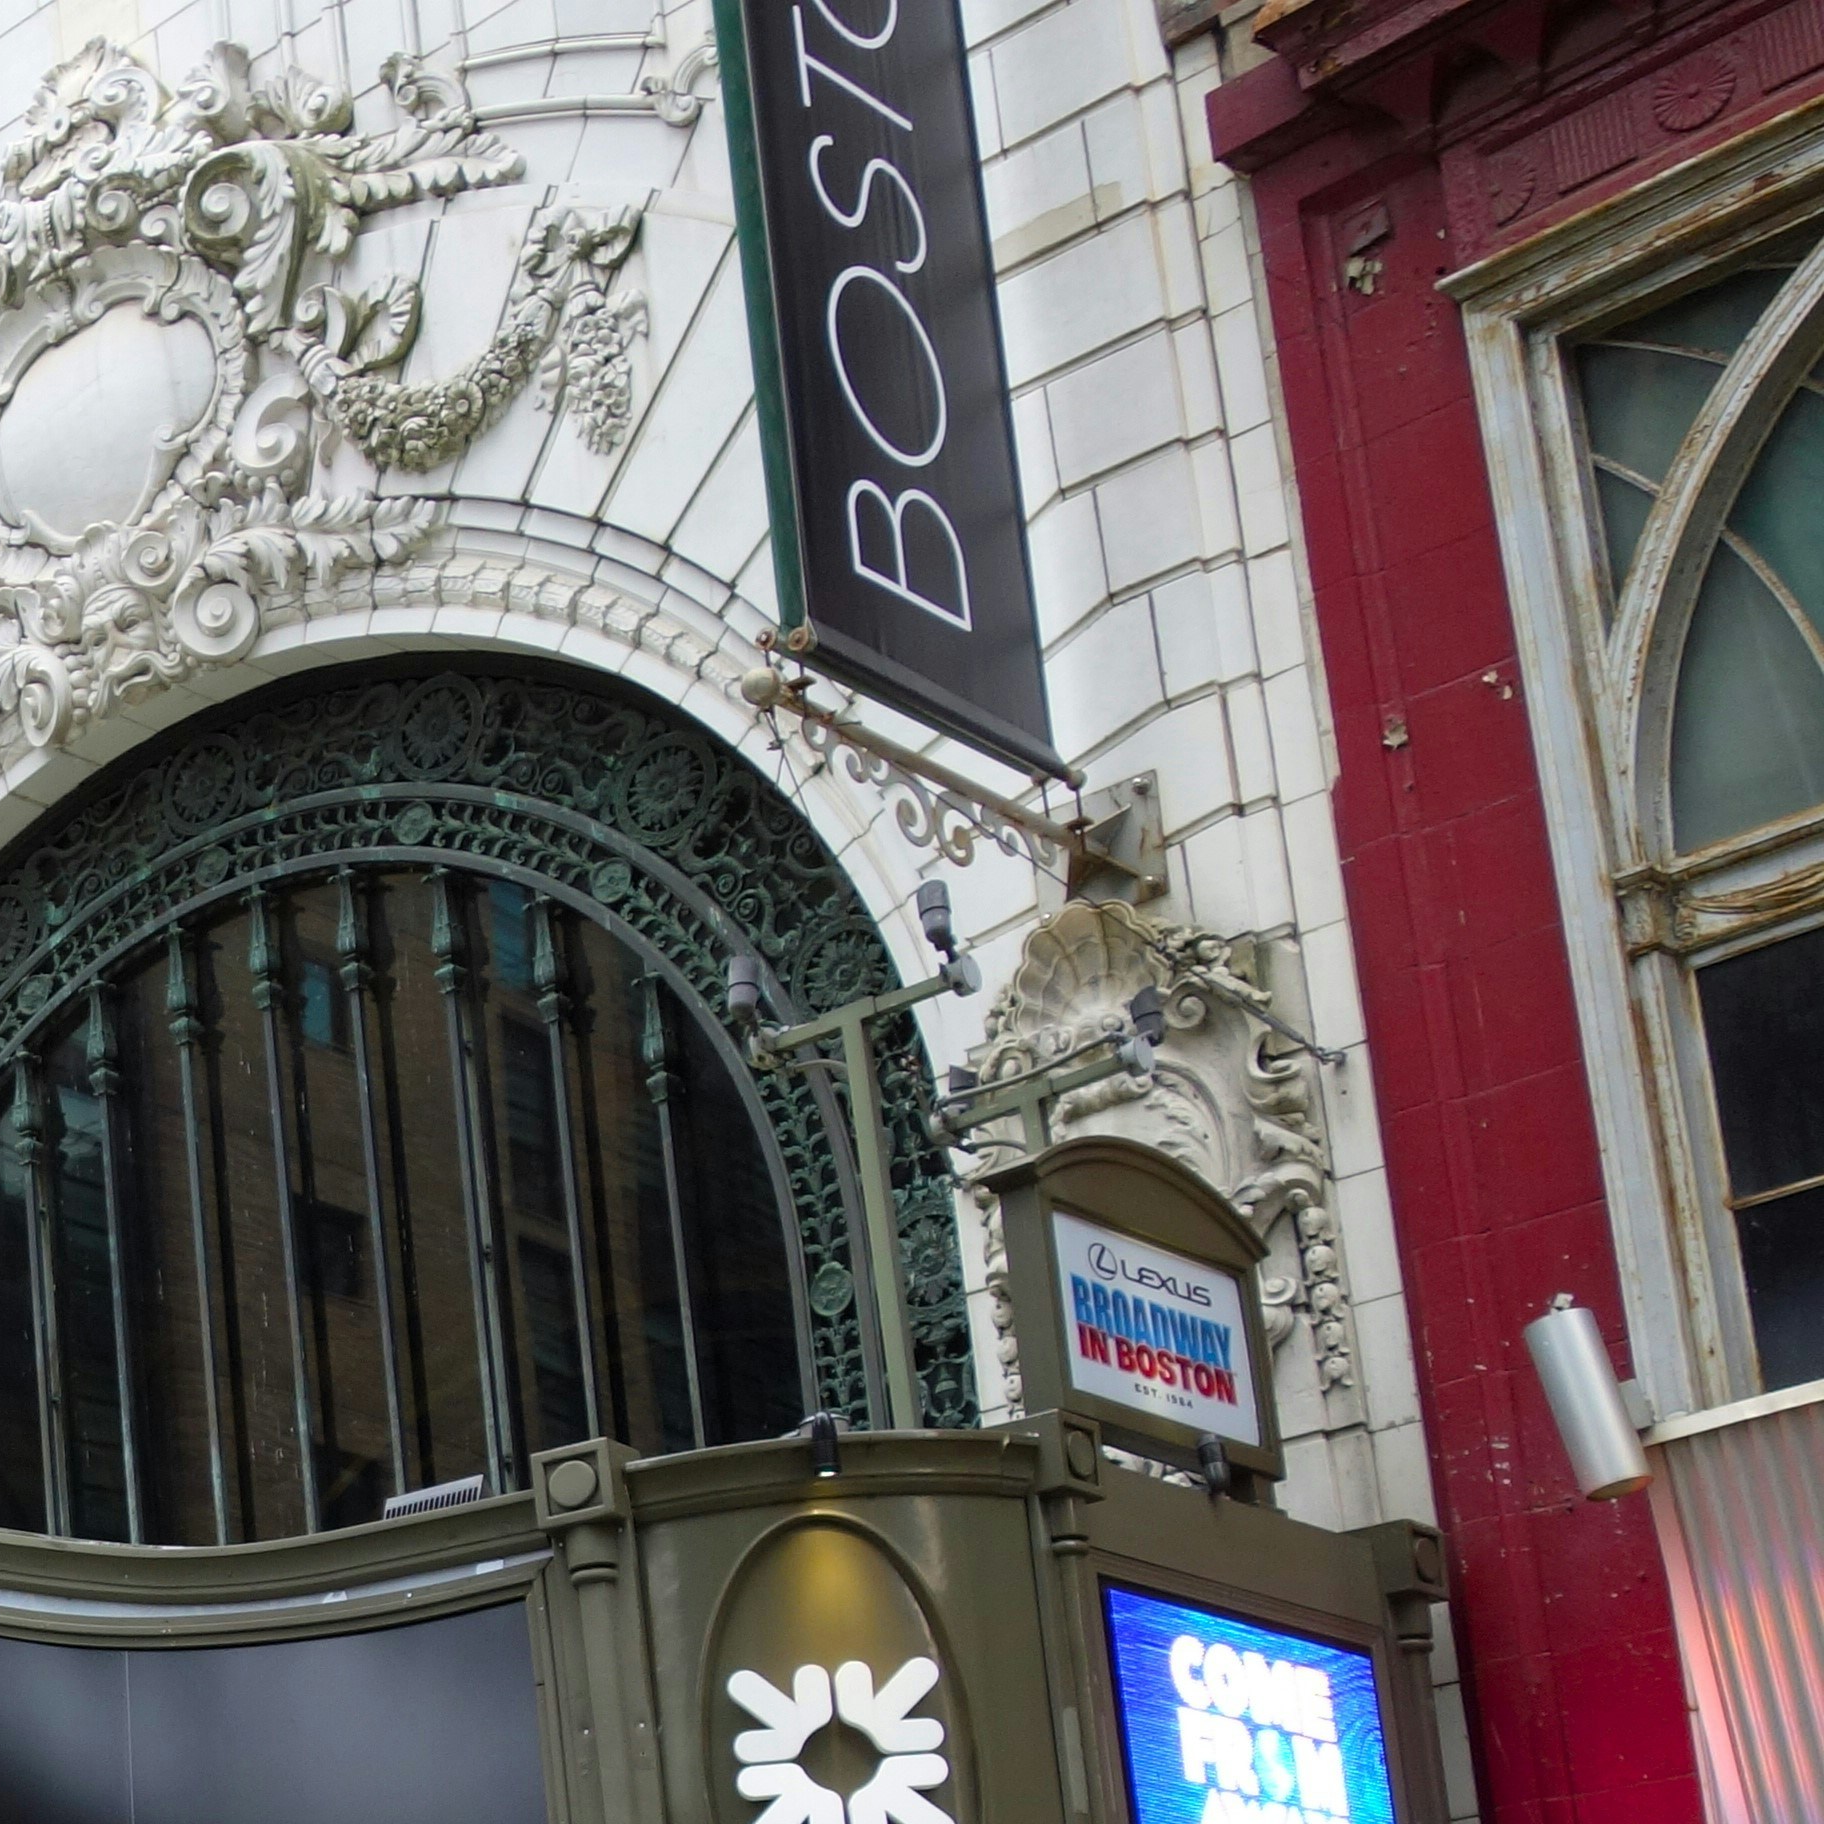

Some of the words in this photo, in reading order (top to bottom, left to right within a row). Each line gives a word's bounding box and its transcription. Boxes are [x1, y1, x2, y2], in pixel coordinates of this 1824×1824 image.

[792, 0, 974, 634] BOST
[1070, 1272, 1232, 1370] BROADWAY
[1121, 1259, 1212, 1307] LEXUS
[1077, 1322, 1112, 1366] IN
[1115, 1334, 1239, 1407] BOSTON
[1169, 1633, 1339, 1744] COME
[1177, 1705, 1350, 1820] FROM
